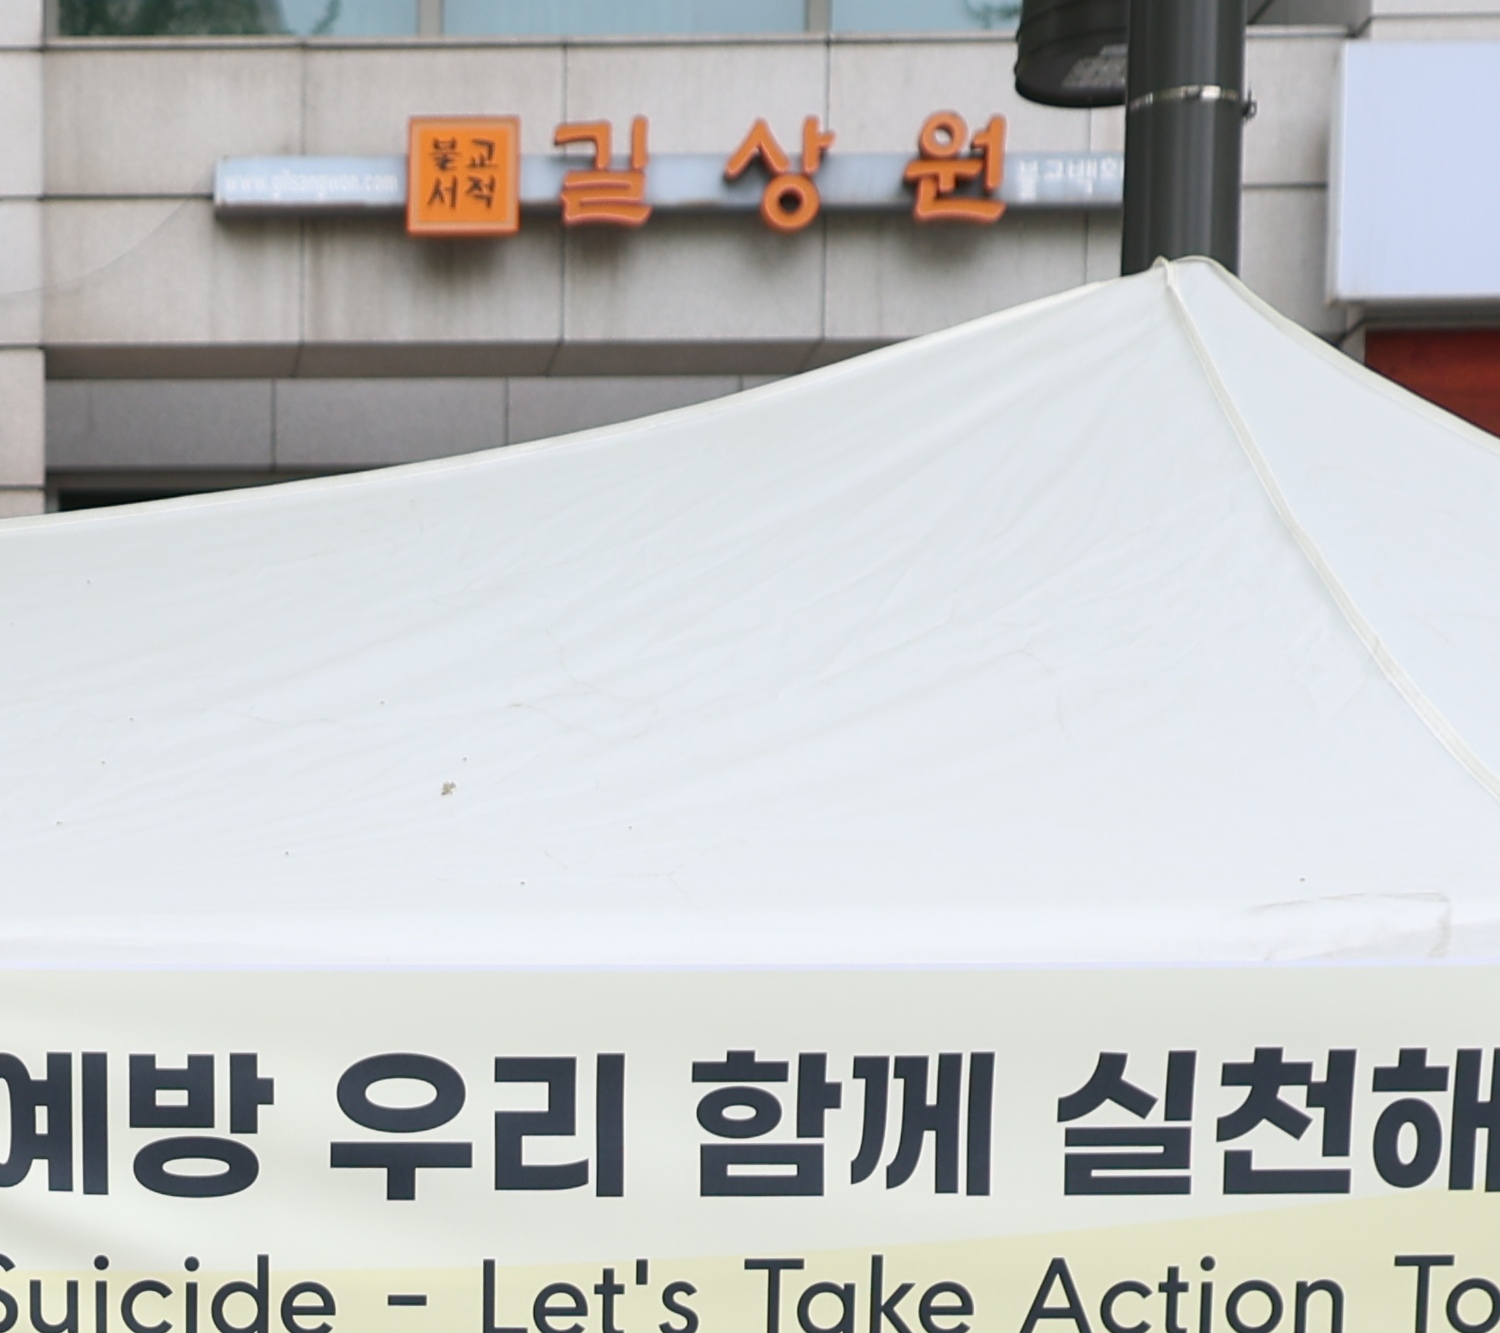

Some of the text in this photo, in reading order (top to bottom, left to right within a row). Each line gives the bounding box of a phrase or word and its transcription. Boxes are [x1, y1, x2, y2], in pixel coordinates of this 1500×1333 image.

[428, 138, 498, 172] 불교
[428, 175, 497, 212] 서적
[329, 1051, 625, 1200] 우리
[690, 1051, 996, 1198] 함께
